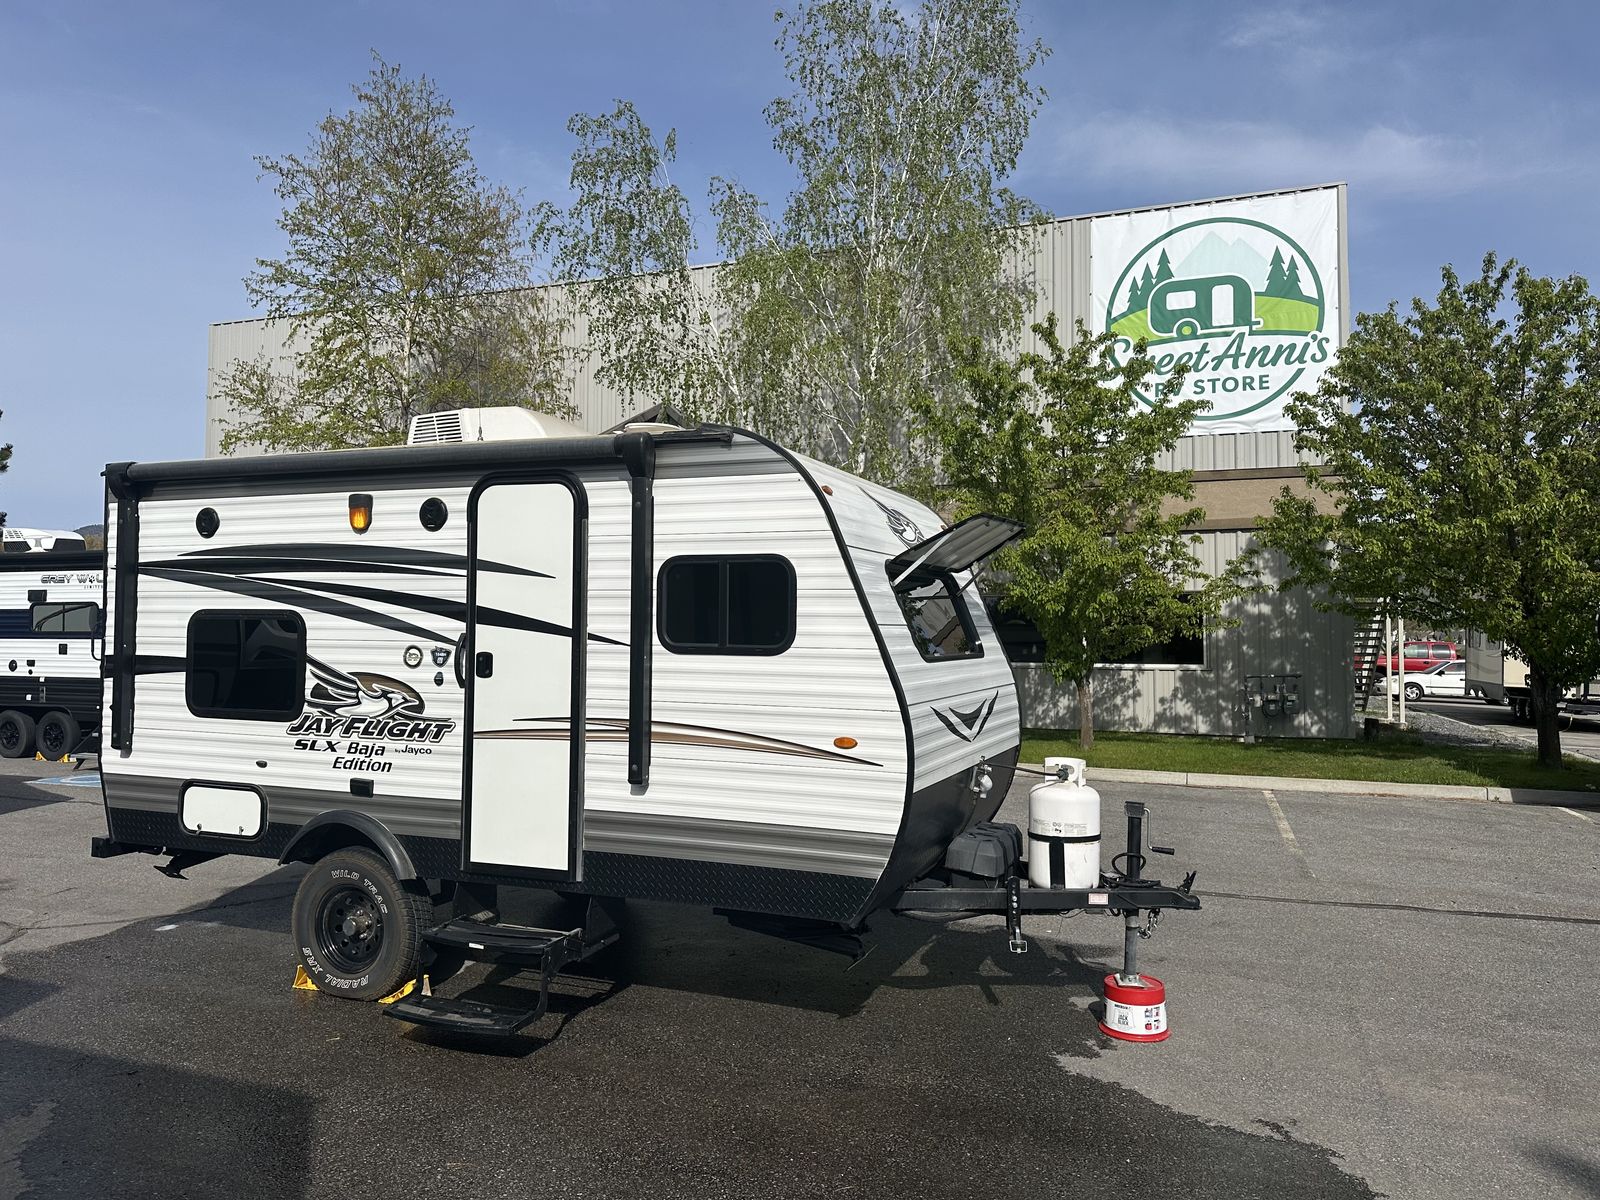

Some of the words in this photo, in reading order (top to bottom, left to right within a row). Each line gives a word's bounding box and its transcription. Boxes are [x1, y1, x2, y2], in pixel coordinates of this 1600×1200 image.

[1207, 329, 1329, 372] Anni's
[1193, 374, 1270, 396] STORE
[41, 574, 73, 584] GREY
[287, 712, 342, 736] JAY
[340, 715, 456, 743] FLIGHT
[293, 739, 341, 753] SLX
[346, 742, 386, 758] Baja
[401, 744, 432, 756] Jayco
[332, 756, 393, 773] Edition
[331, 869, 360, 881] WILD
[363, 878, 388, 914] TRAC
[324, 974, 369, 989] RADIAL
